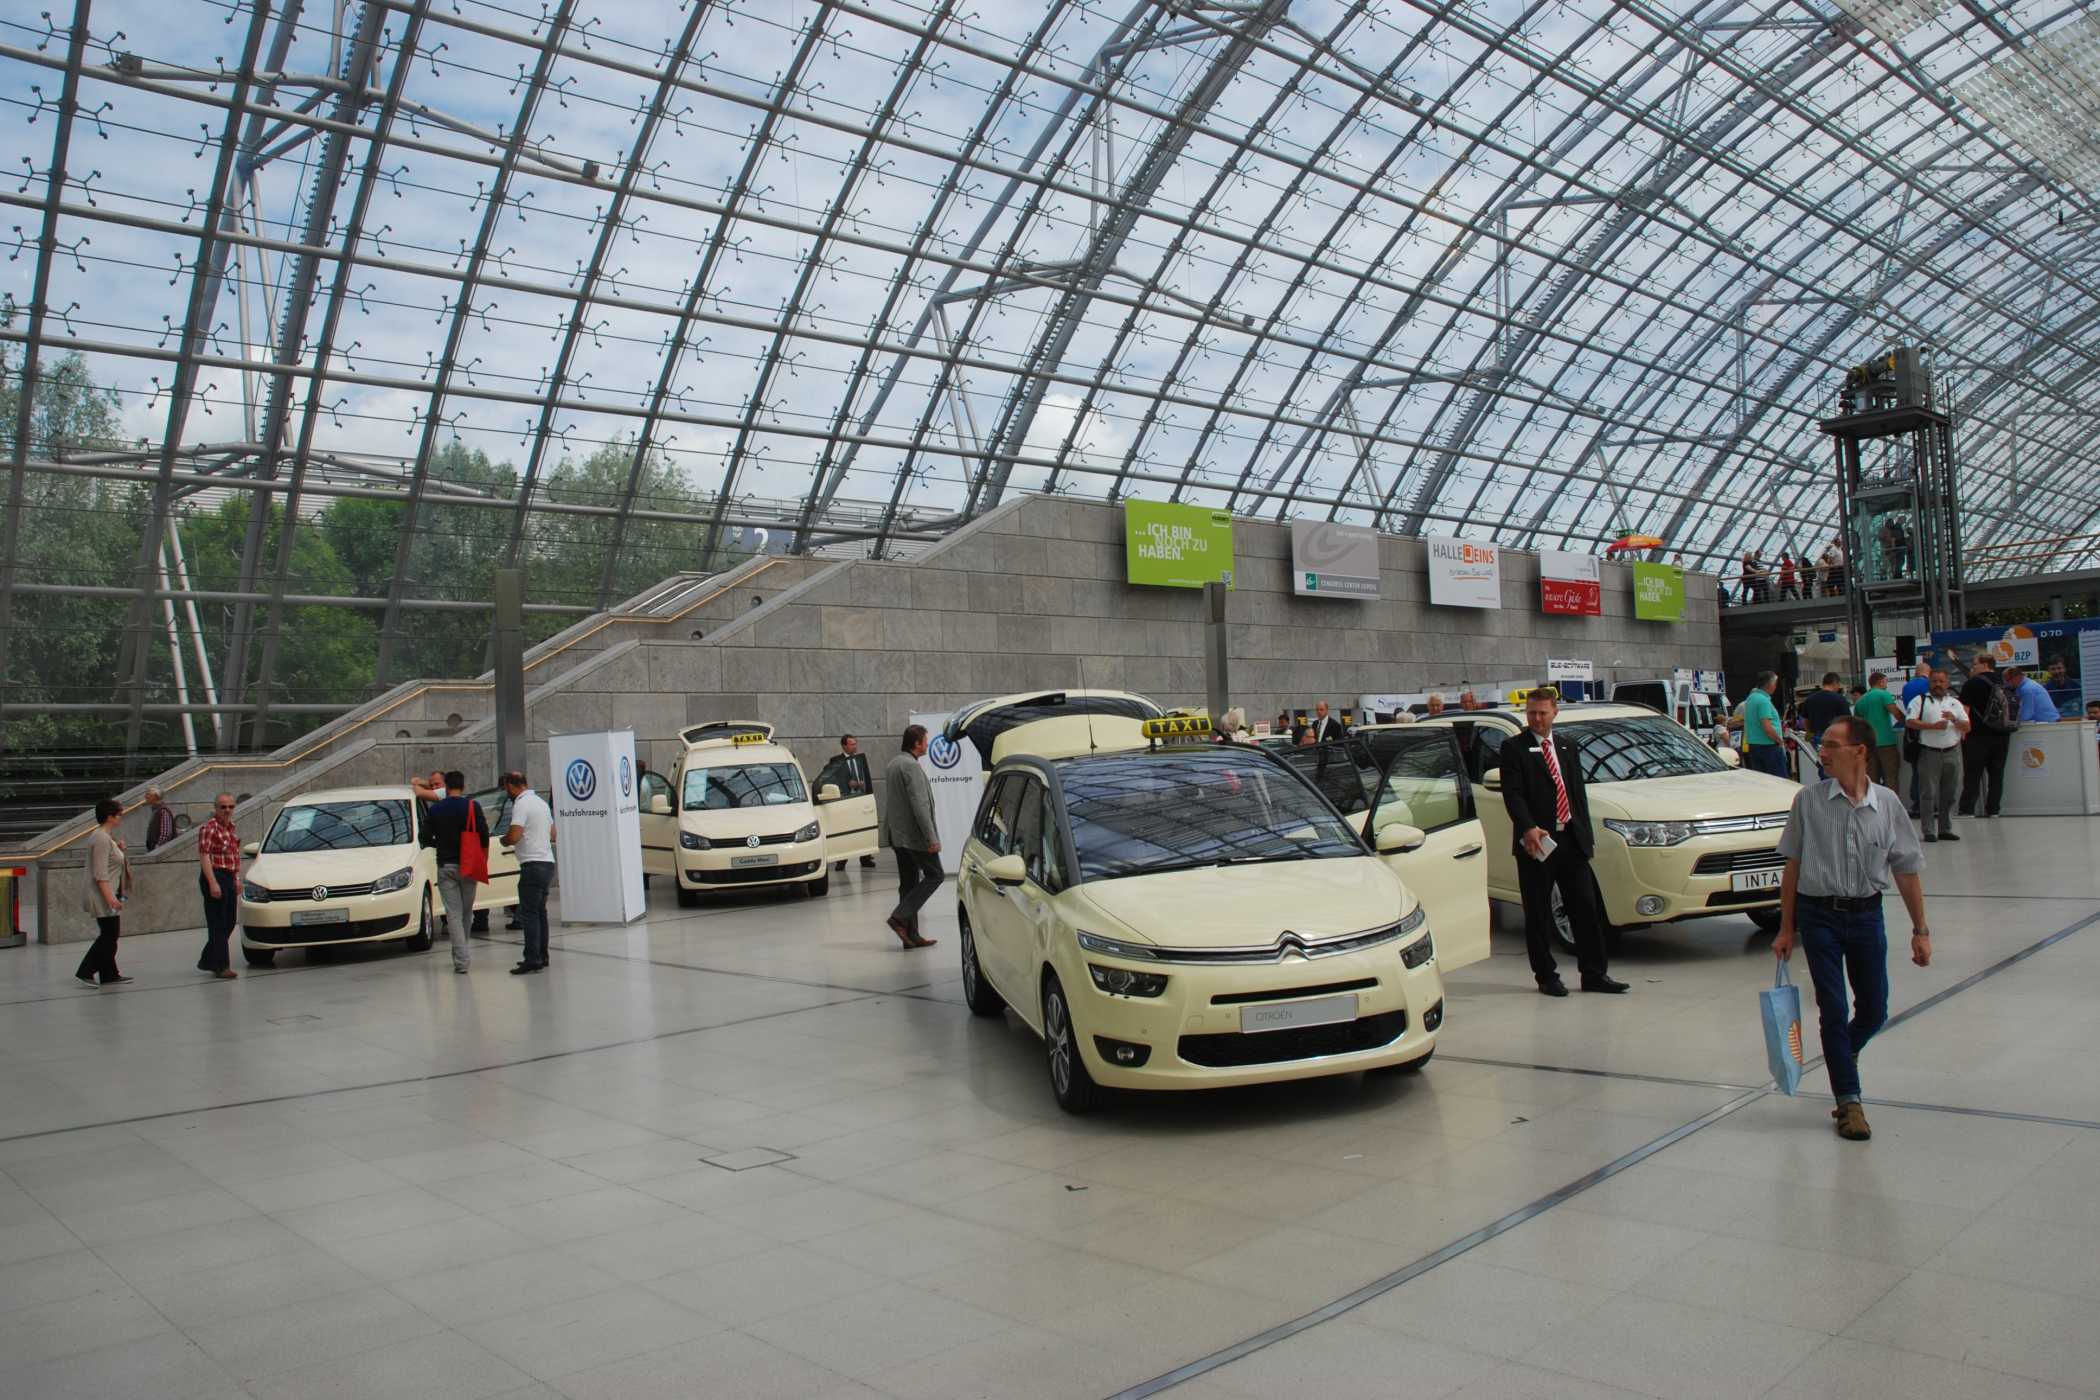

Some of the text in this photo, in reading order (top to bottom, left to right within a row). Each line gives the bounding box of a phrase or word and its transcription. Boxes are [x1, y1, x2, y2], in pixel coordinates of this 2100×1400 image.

[1171, 526, 1192, 539] BIN
[1138, 544, 1185, 560] HABEN.
[1155, 536, 1208, 552] NOCH ZU
[1433, 544, 1495, 564] HALLE EINS
[1157, 718, 1201, 733] TAXI
[560, 807, 608, 818] Nutzfahrzeuge
[1745, 871, 1780, 888] INTA
